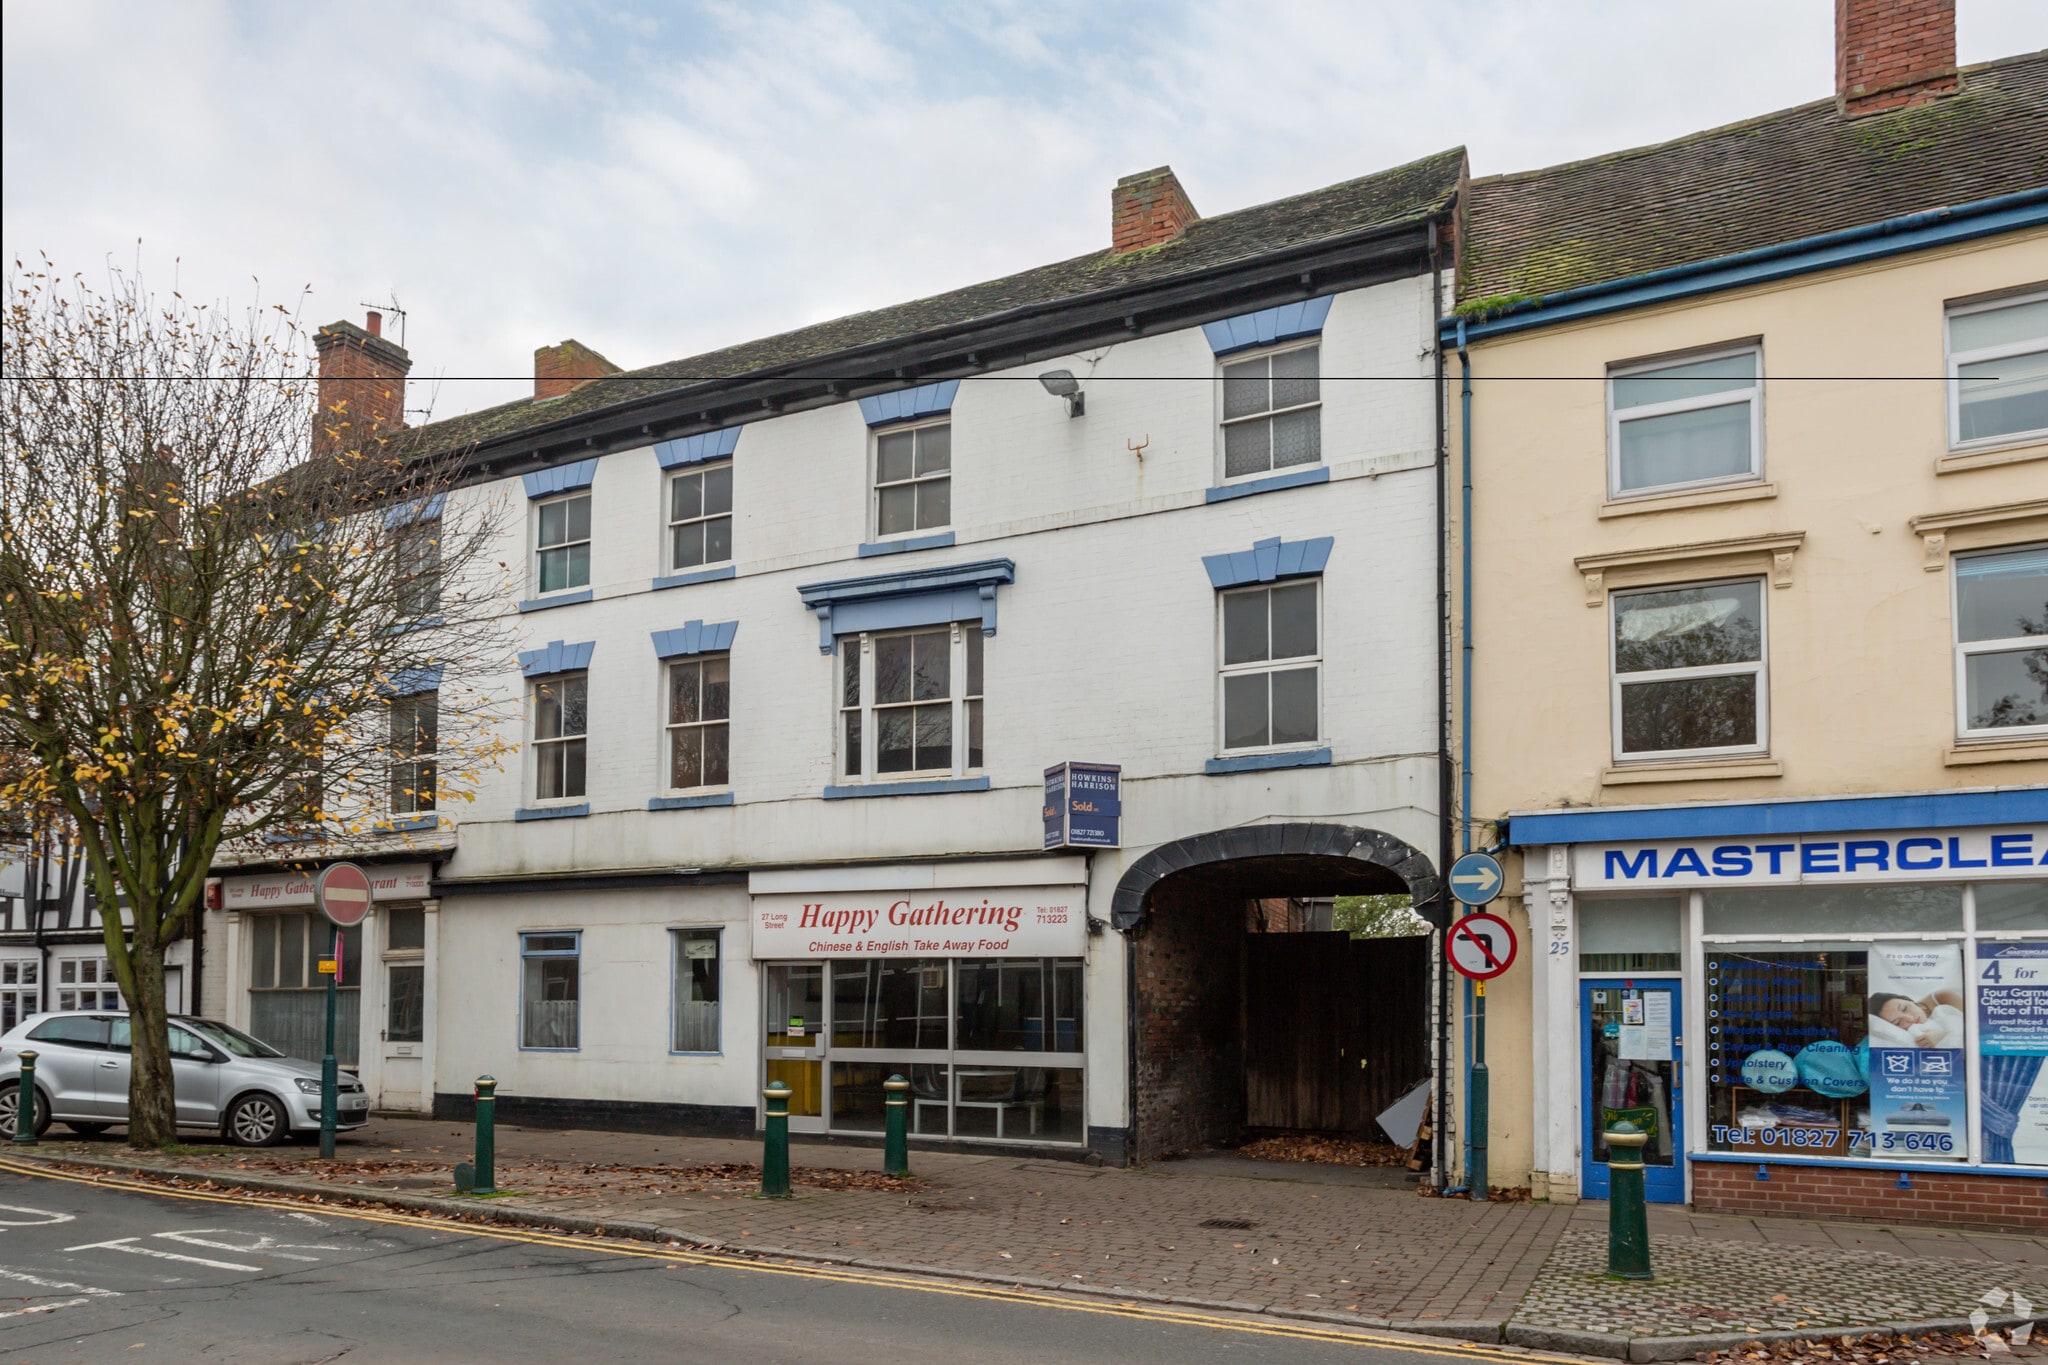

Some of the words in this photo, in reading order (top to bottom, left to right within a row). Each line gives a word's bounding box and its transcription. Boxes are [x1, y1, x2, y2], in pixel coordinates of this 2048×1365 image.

[1071, 773, 1111, 783] HOWKINS
[1071, 781, 1116, 791] HARRISON
[1072, 800, 1093, 812] Sold
[1604, 832, 2048, 880] MASTERCLE
[250, 883, 282, 899] Happy
[285, 880, 315, 895] Gathe
[771, 913, 788, 921] Long
[798, 903, 880, 934] Happy
[888, 899, 1023, 932] Gathering
[1036, 914, 1068, 924] 713223
[808, 941, 852, 952] Chinese
[855, 941, 864, 951] &
[866, 940, 908, 953] English
[914, 940, 939, 950] Take
[942, 940, 974, 952] Away
[978, 939, 1009, 950] Food
[1549, 941, 1569, 955] 25
[1982, 960, 2002, 984] 4
[2014, 967, 2038, 979] for
[1983, 988, 2008, 997] Four
[1980, 997, 2032, 1006] Cleaned
[1987, 1006, 2016, 1015] Price
[2019, 1006, 2031, 1015] of
[1722, 1025, 1782, 1036] Motorbike
[1786, 1026, 1839, 1037] Leathers
[1722, 1043, 1762, 1053] Carpet
[1765, 1042, 1773, 1051] &
[1777, 1043, 1801, 1053] Rug
[1806, 1043, 1861, 1055] Cleaning
[1722, 1058, 1787, 1070] Upholstery
[1724, 1075, 1753, 1085] Suite
[1756, 1075, 1764, 1084] &
[1768, 1075, 1819, 1086] Cushion
[1822, 1076, 1866, 1087] Covers
[1935, 1086, 1944, 1094] to
[1712, 1124, 1755, 1145] Tel:
[1761, 1127, 1840, 1148] 01827
[1849, 1131, 1895, 1149] 713
[1904, 1133, 1953, 1152] 646
